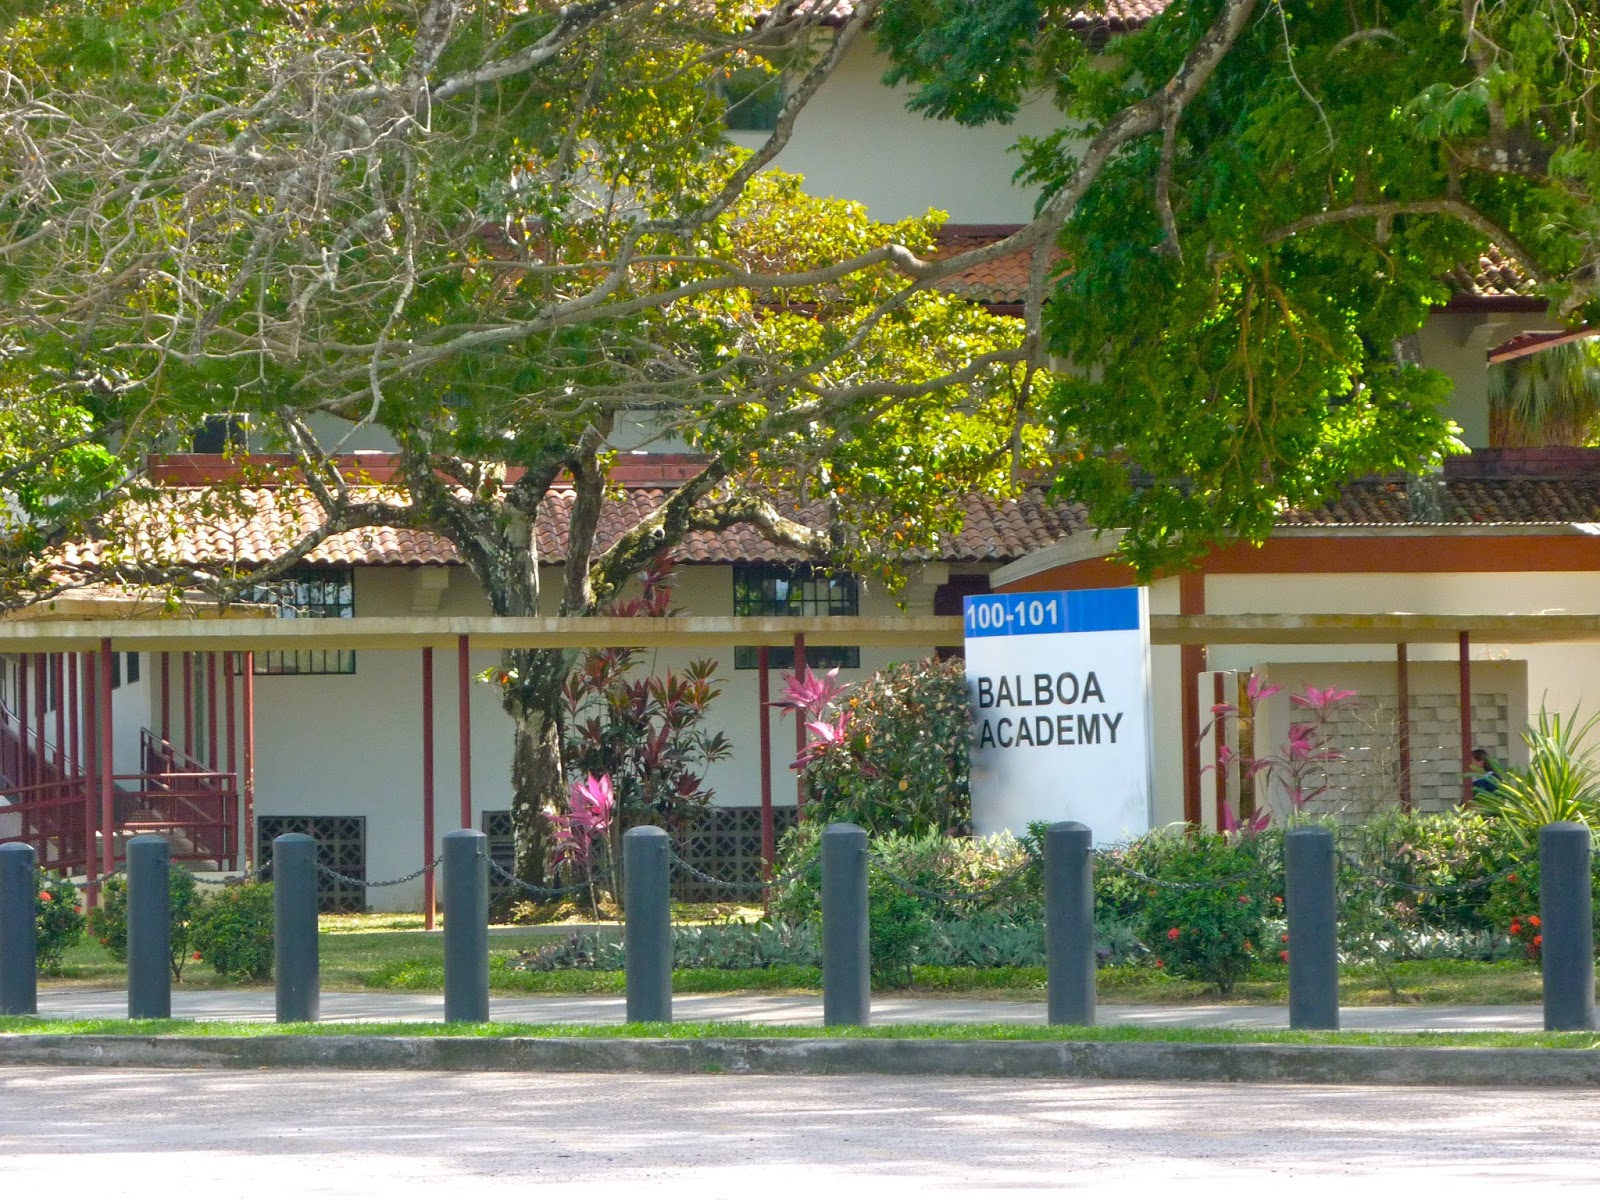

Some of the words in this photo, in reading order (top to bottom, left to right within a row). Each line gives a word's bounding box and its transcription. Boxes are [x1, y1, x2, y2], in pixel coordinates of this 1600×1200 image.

[967, 599, 1058, 629] 100-101
[978, 671, 1106, 709] BALBOA
[980, 712, 1124, 749] ACADEMY
